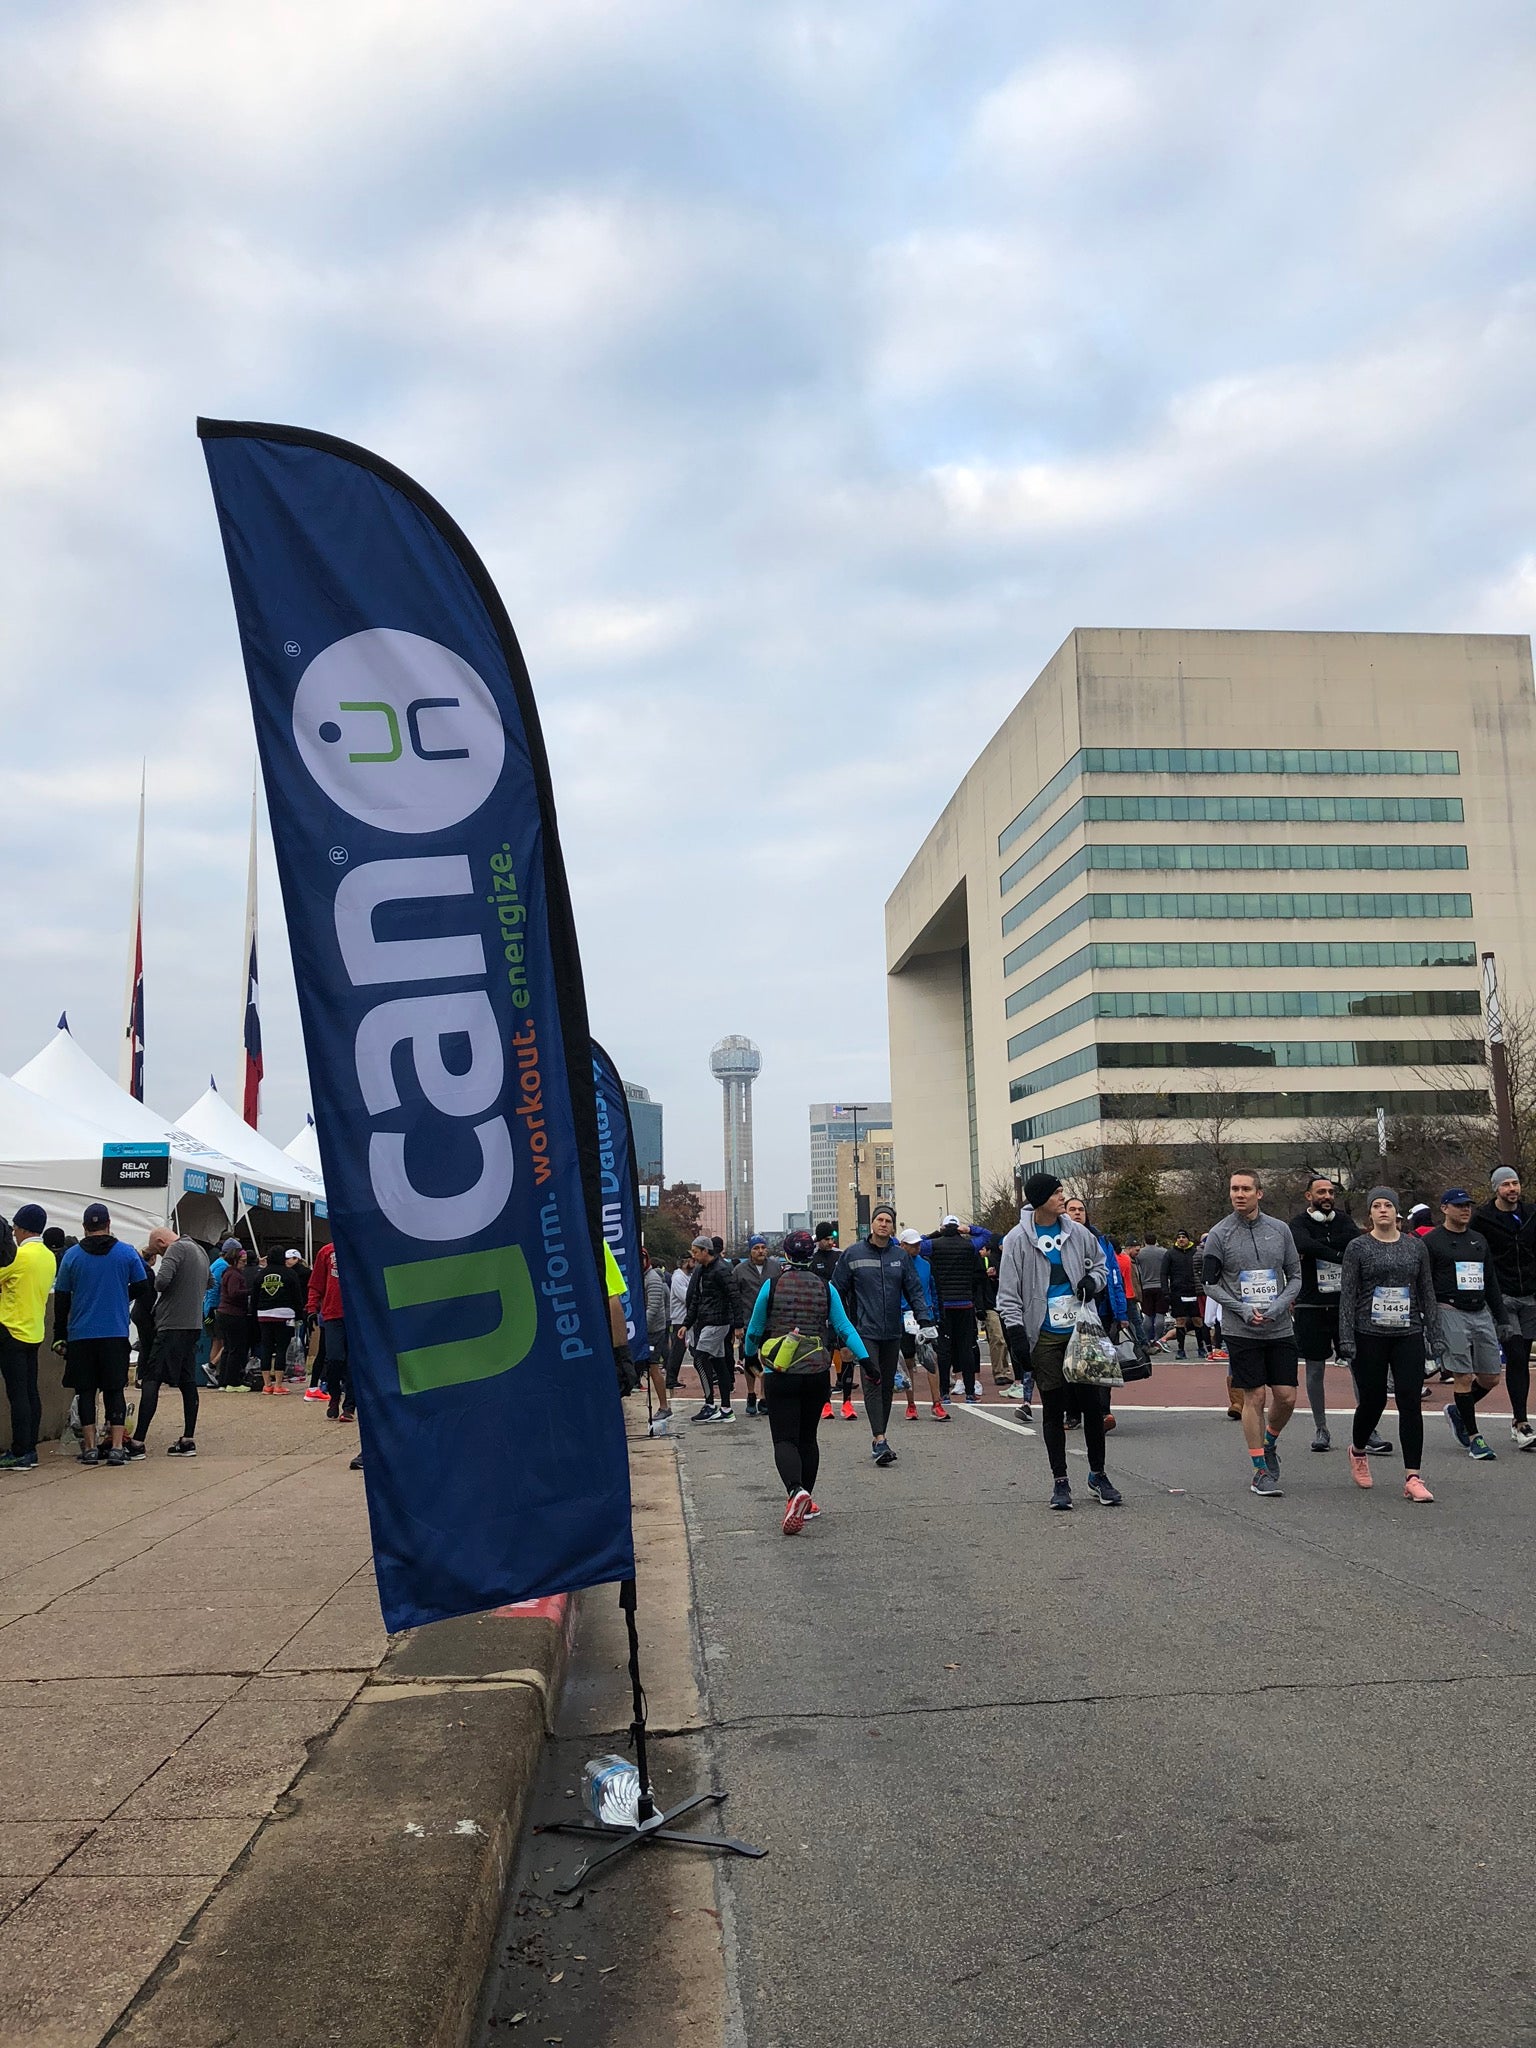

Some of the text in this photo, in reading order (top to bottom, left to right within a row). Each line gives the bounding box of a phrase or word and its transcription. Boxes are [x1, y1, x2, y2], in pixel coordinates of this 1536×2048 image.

[487, 843, 593, 1361] perform. workout. energize.
[334, 855, 537, 1395] ucan
[122, 1162, 149, 1170] RELAY
[119, 1171, 151, 1179] SHIRTS
[1243, 1285, 1276, 1295] C 14699
[1373, 1303, 1409, 1312] C 14454
[1053, 1313, 1060, 1321] C
